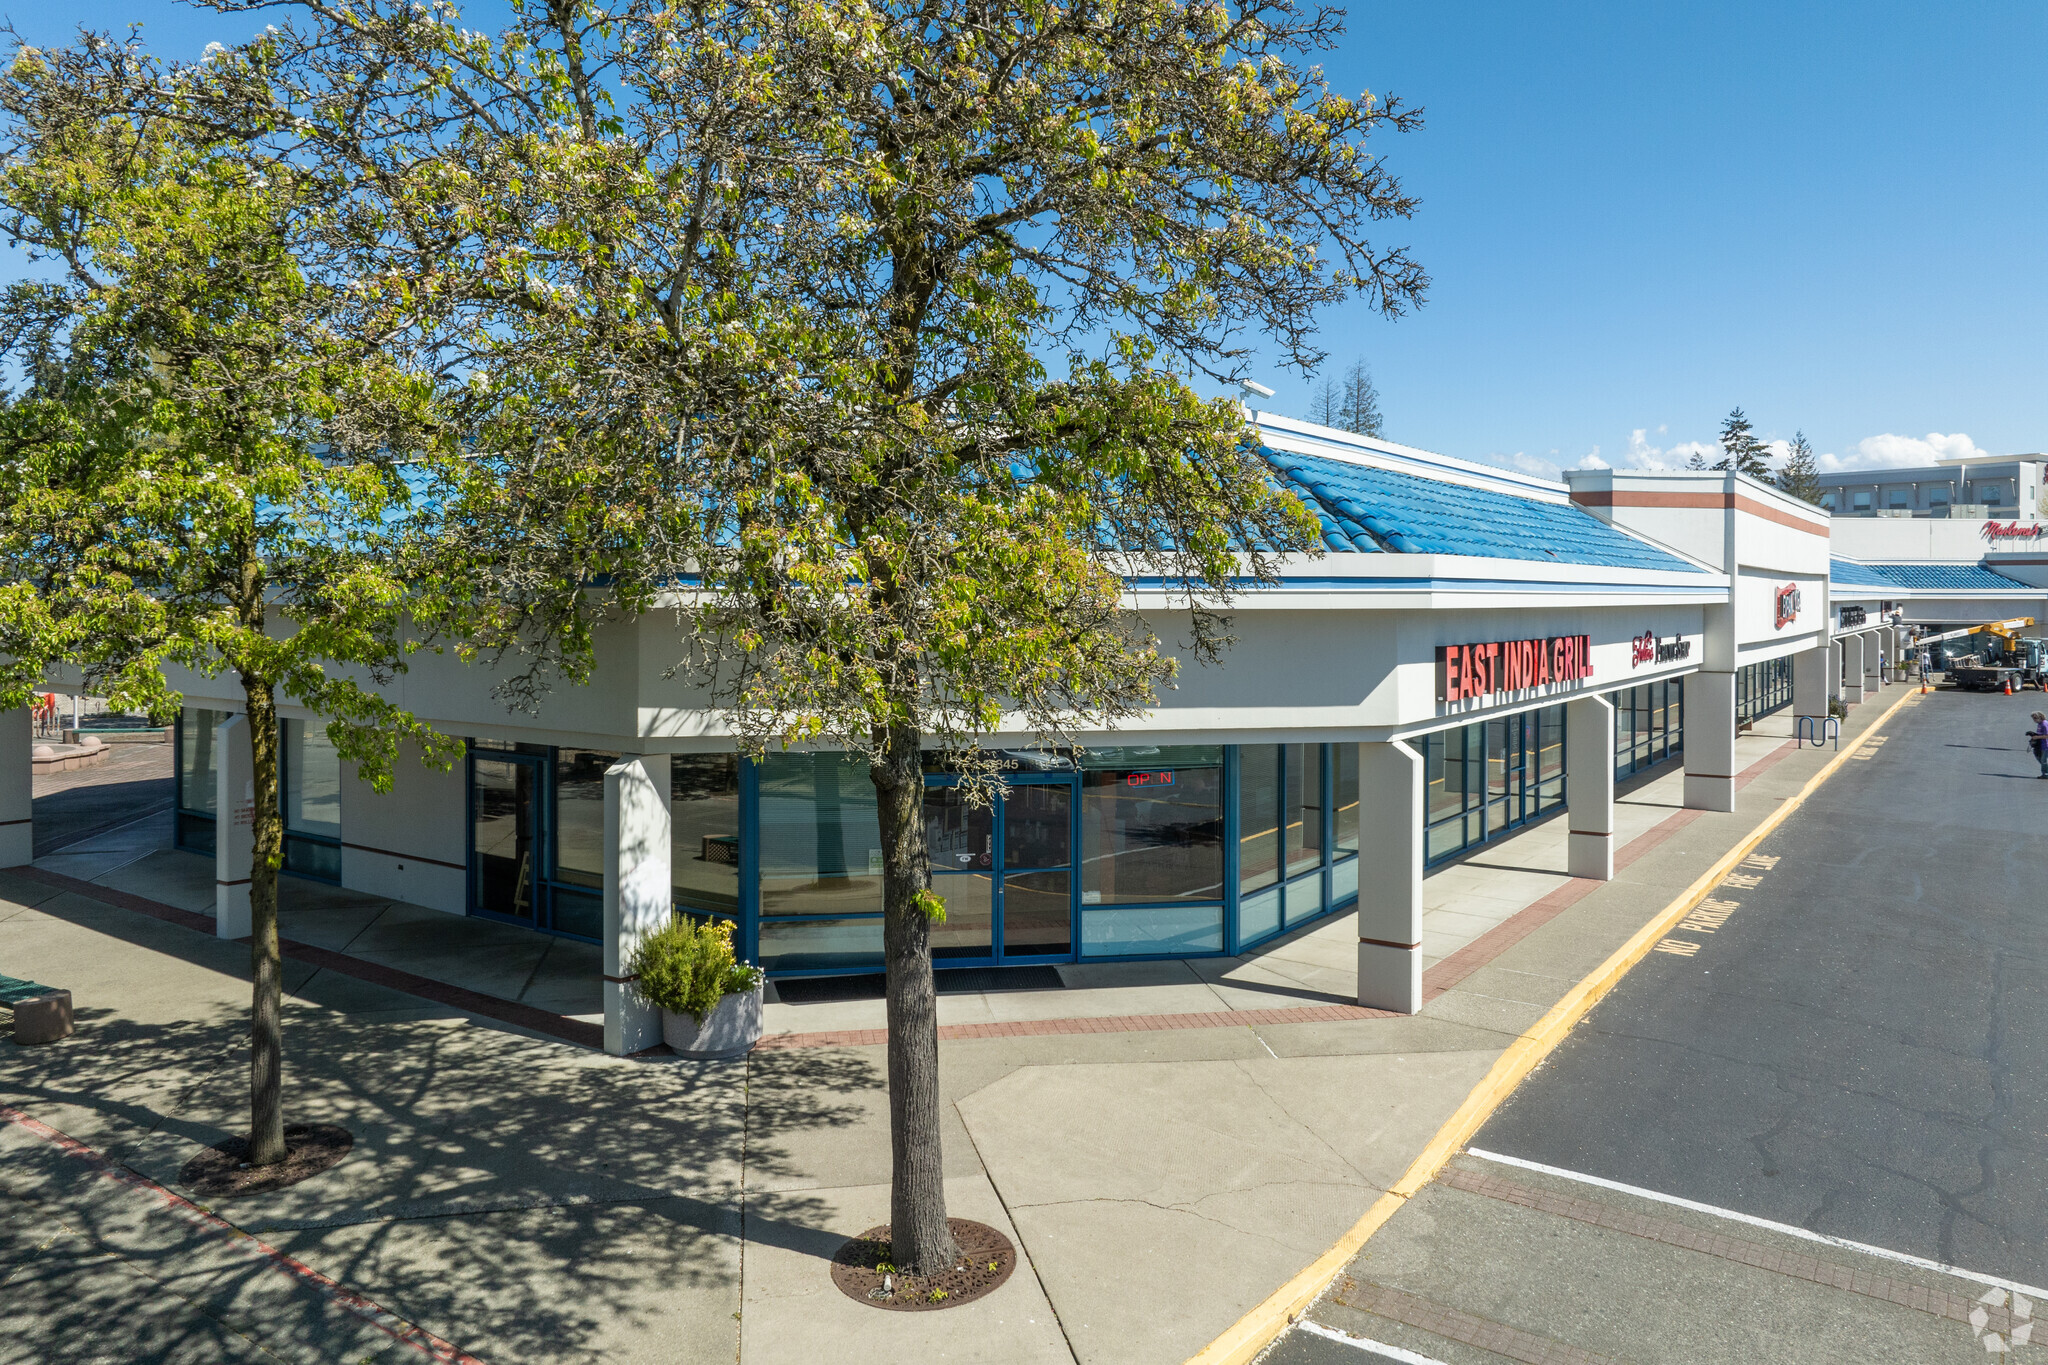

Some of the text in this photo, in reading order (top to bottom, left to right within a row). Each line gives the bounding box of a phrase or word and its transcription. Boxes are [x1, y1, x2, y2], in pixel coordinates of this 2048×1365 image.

[1446, 634, 1594, 702] EAST INDIA GRILL
[1127, 772, 1172, 786] OPN
[1653, 853, 1782, 957] NO PARKING FIRE LANE
